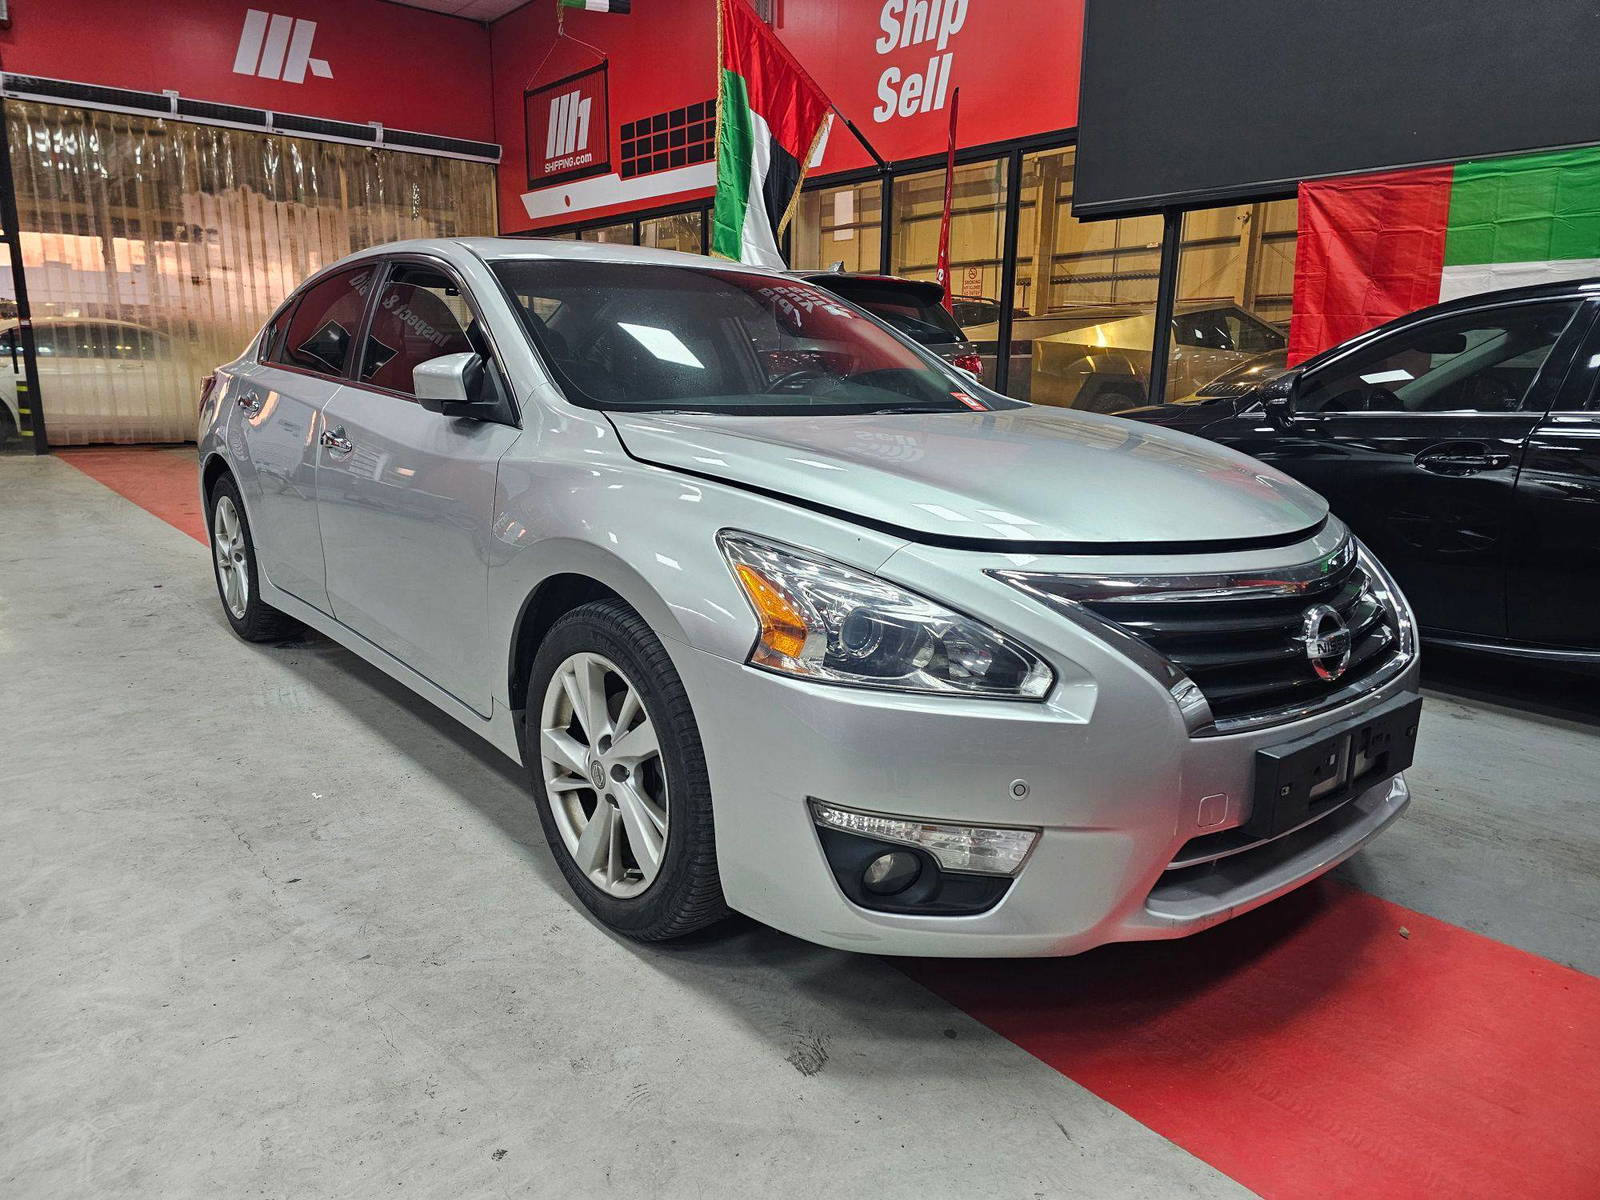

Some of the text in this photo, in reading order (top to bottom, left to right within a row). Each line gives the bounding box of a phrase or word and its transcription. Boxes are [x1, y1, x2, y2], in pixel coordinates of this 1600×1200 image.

[876, 0, 968, 54] Ship
[873, 53, 953, 123] Sell
[545, 153, 592, 173] SHIPPING.com
